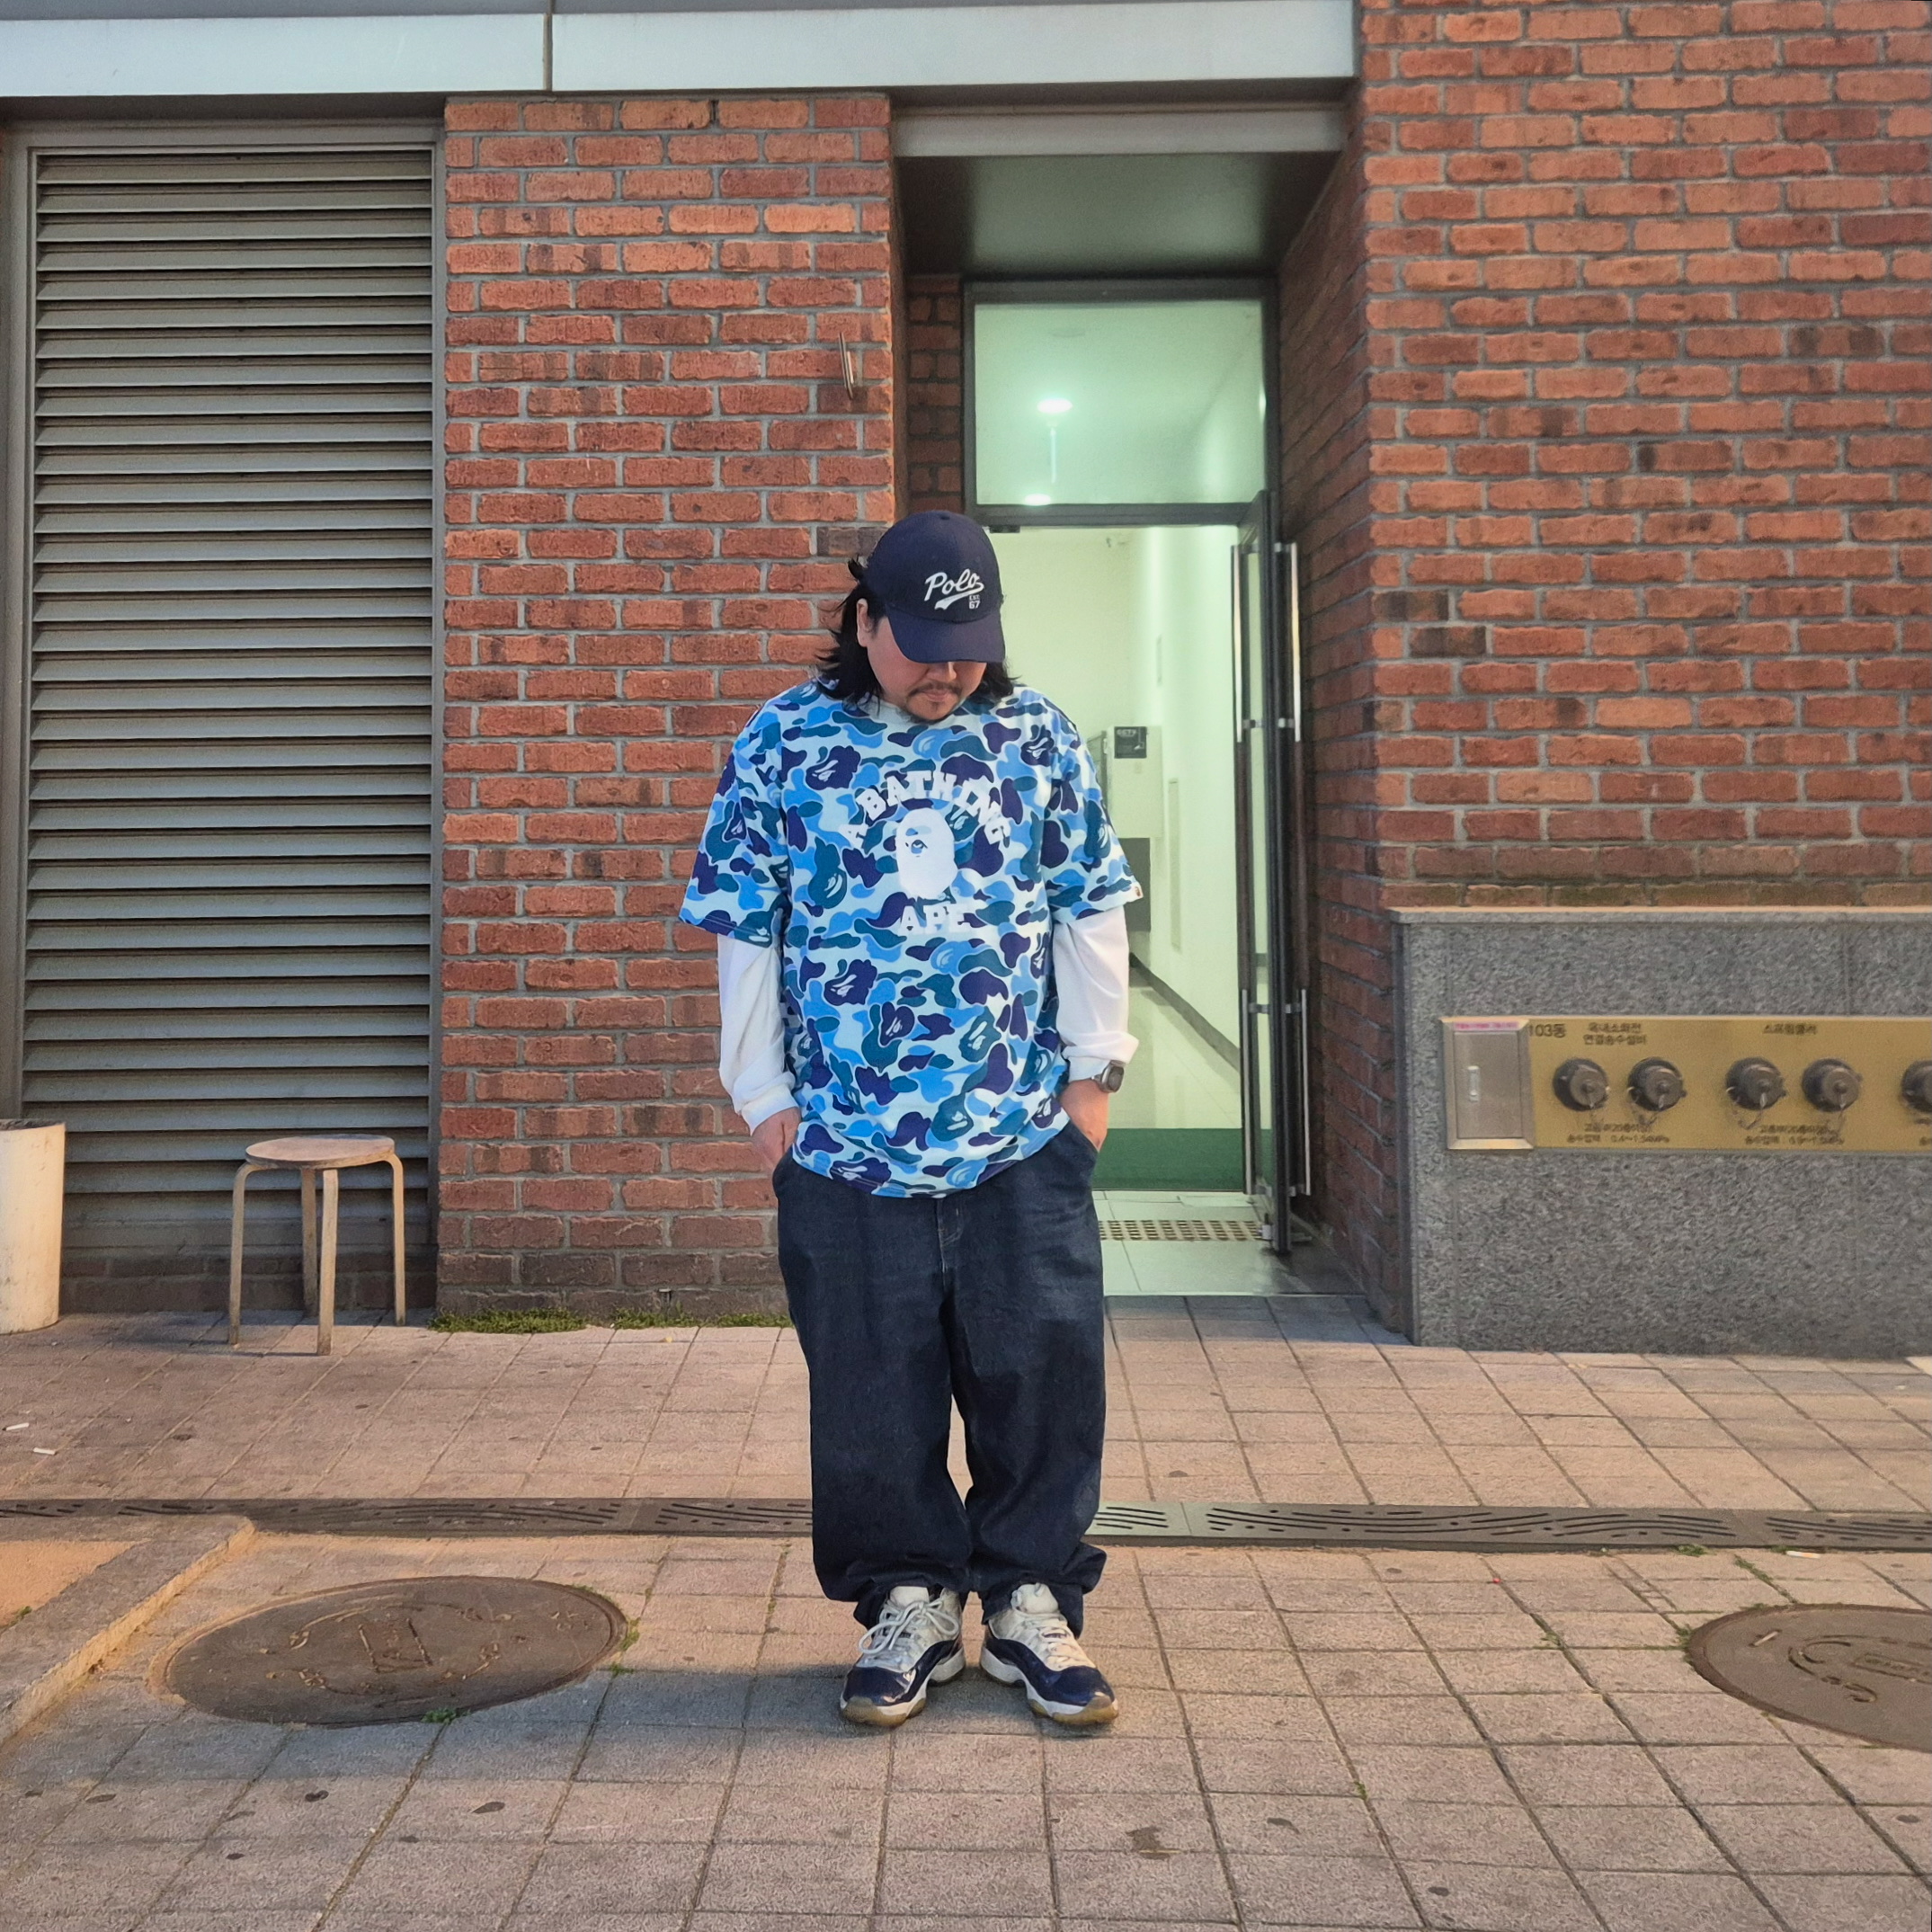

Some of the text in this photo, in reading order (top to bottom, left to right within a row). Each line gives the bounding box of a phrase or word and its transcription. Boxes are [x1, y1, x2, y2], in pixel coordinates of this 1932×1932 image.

[924, 568, 984, 610] Polo
[969, 600, 981, 609] 67
[839, 824, 869, 849] A
[899, 902, 973, 933] APE
[1529, 1023, 1566, 1038] 103동
